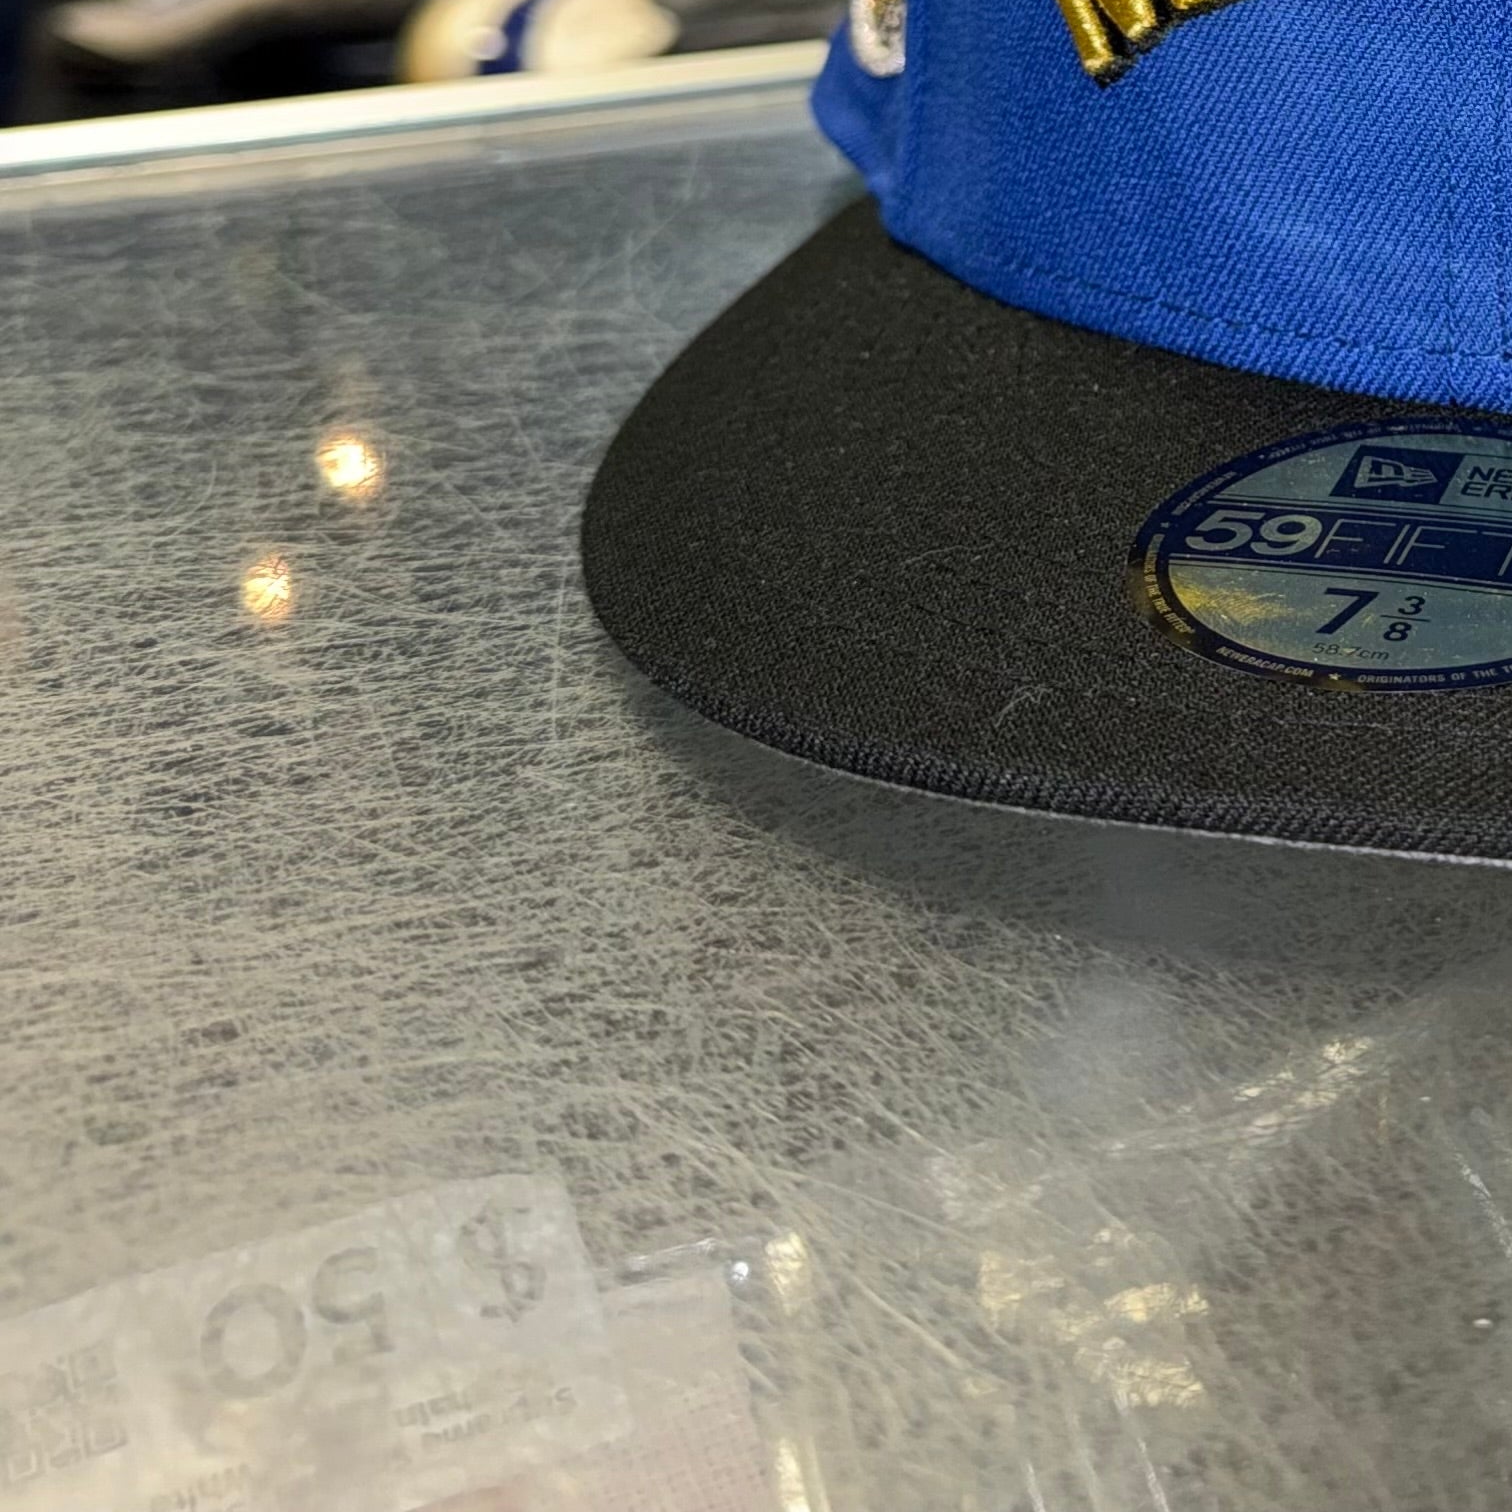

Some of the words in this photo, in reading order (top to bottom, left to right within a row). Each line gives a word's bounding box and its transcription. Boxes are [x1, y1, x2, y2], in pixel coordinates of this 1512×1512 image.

[1315, 587, 1379, 635] 7
[1216, 645, 1315, 678] NEWERACAP.COM
[1356, 673, 1446, 685] ORIGINATORS
[1450, 671, 1467, 681] OF
[1471, 668, 1499, 679] THE
